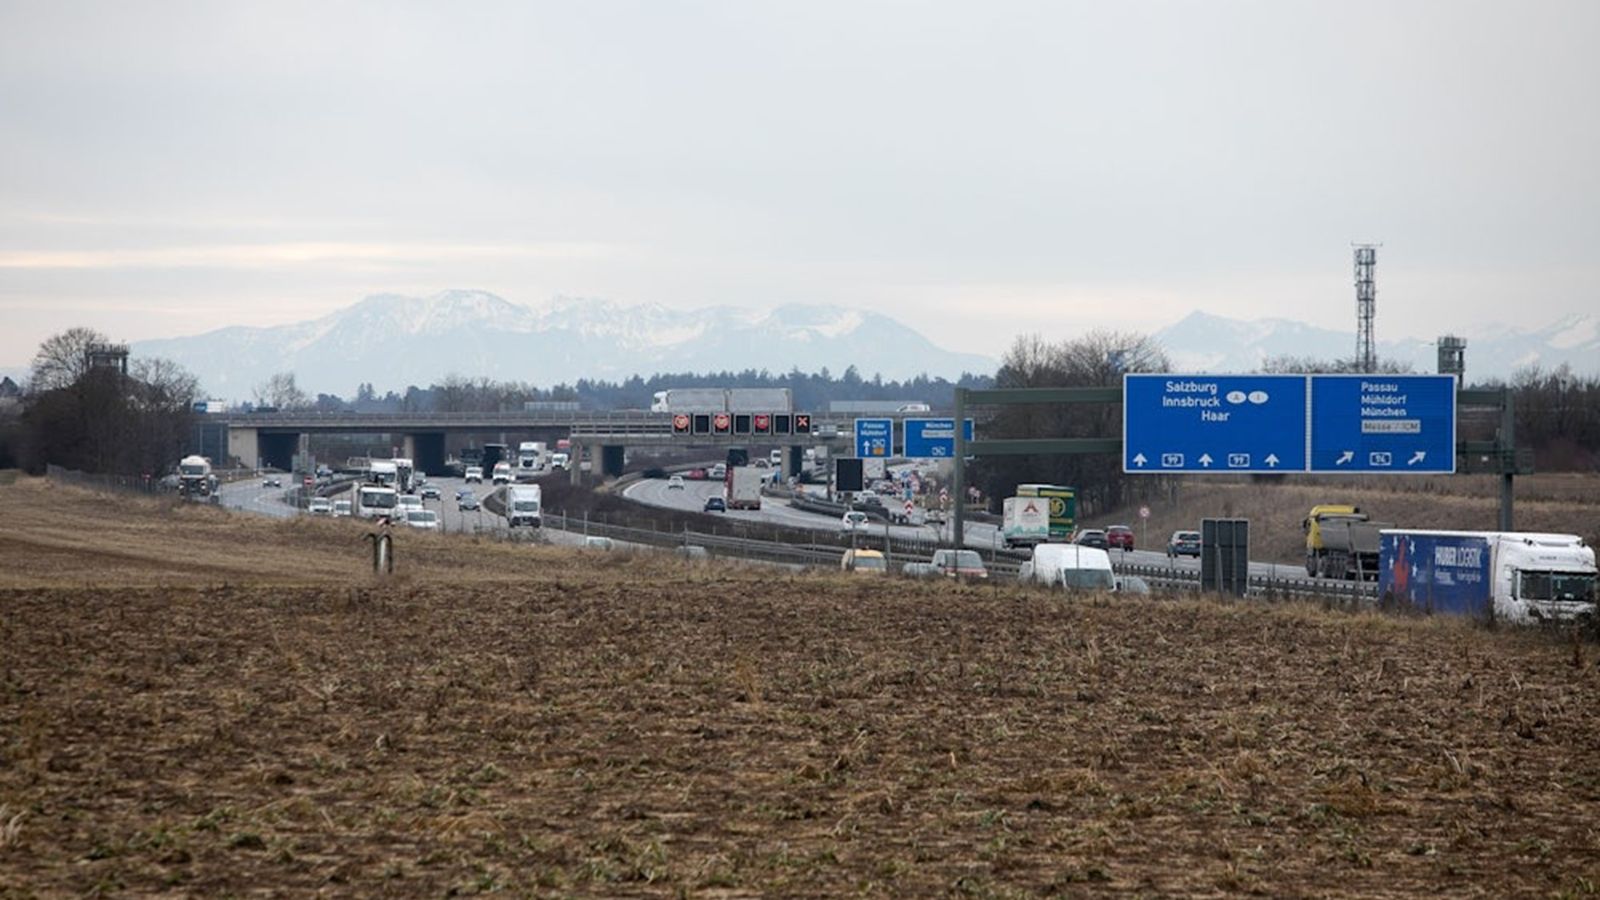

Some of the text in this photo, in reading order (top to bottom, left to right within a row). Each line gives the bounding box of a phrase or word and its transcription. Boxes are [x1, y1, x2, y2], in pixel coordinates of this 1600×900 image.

[1166, 381, 1217, 395] Salzburg
[1361, 381, 1398, 392] Passau
[1162, 396, 1220, 407] Innsbruck
[1361, 394, 1407, 404] Mühldorf
[1201, 410, 1230, 421] Haar
[1361, 407, 1407, 416] München
[1434, 546, 1457, 566] HUBER
